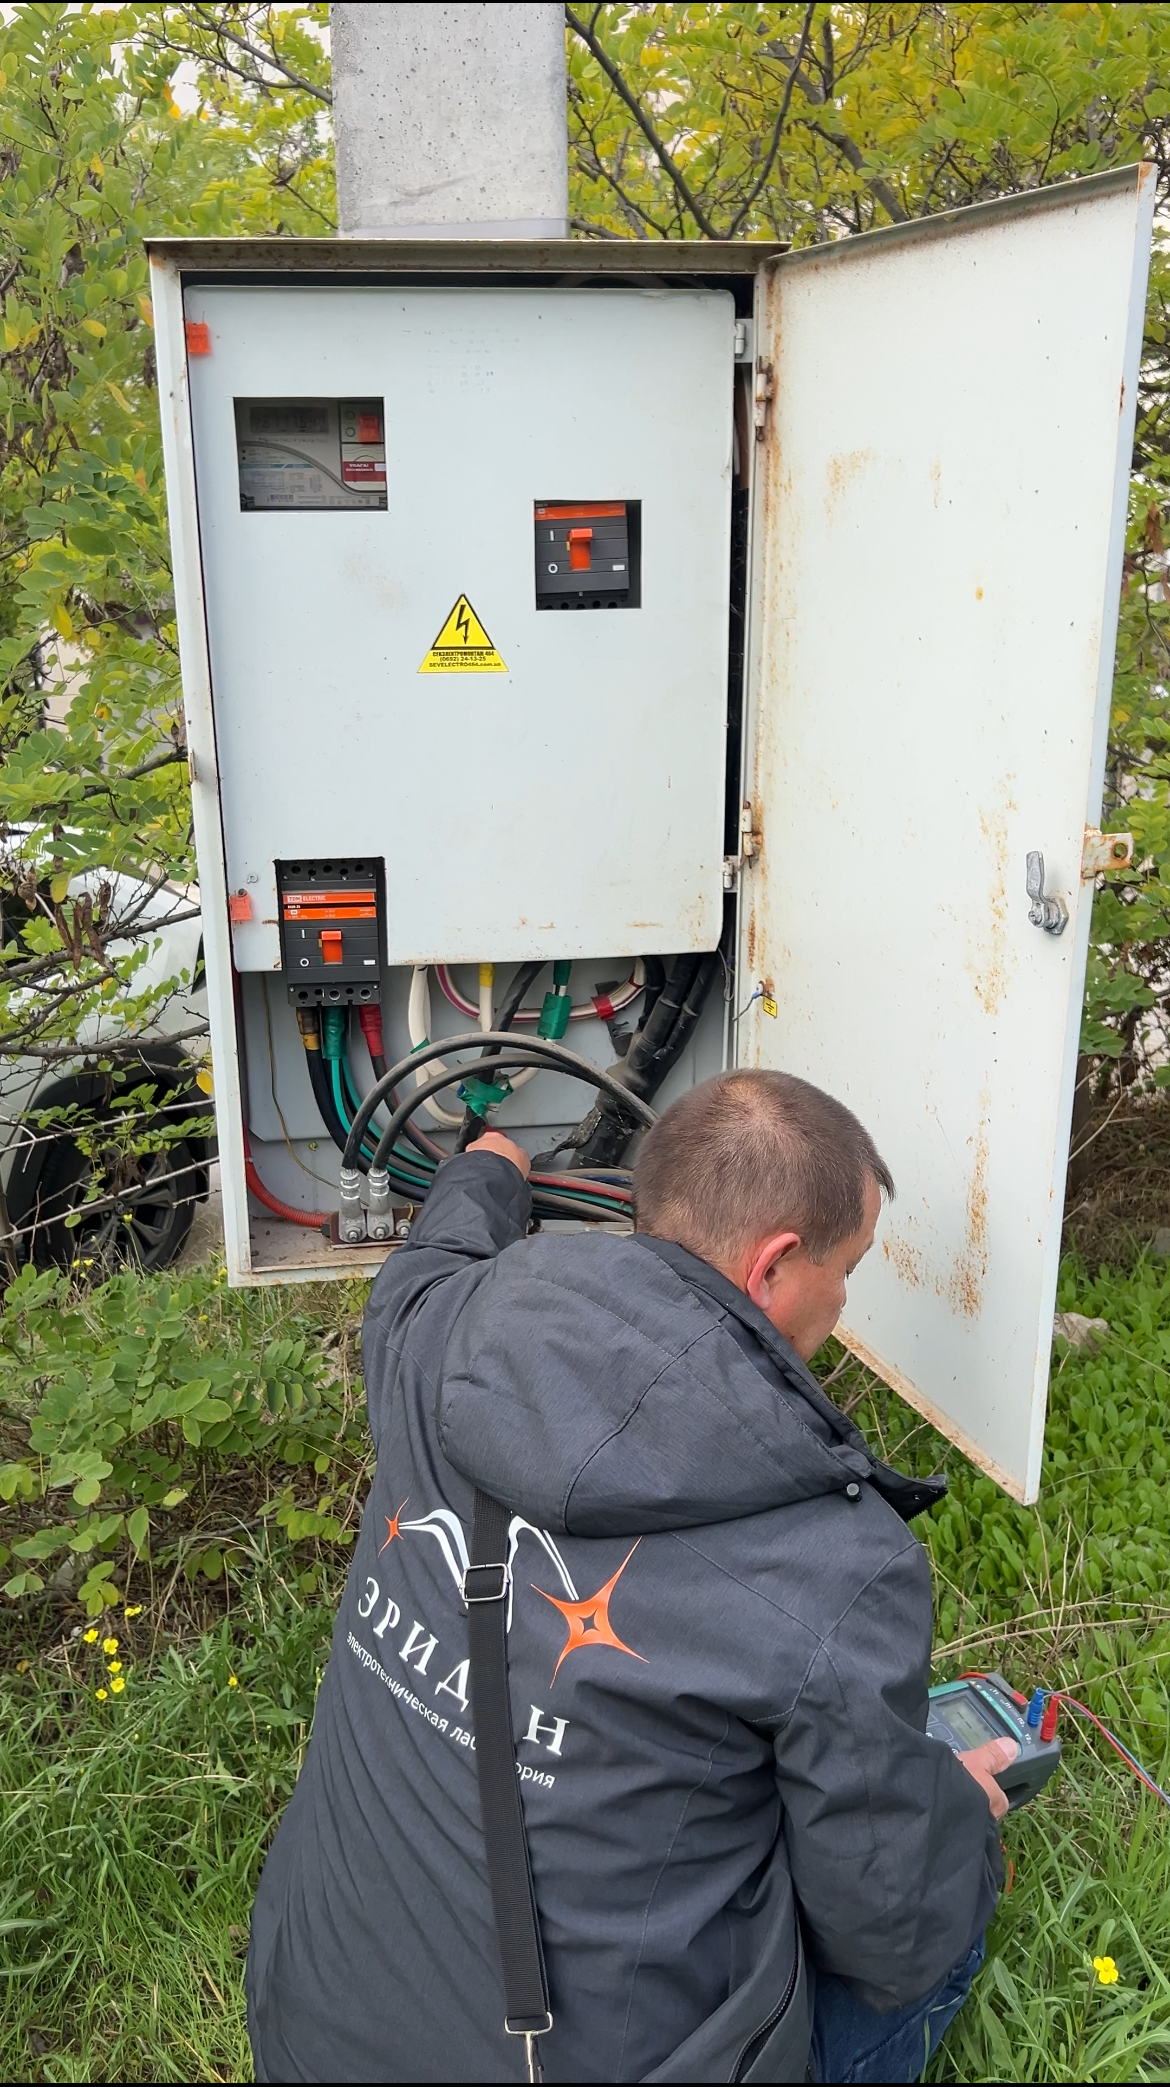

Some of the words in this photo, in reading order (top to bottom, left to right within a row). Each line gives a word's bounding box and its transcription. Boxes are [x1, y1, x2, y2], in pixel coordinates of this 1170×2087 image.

[346, 1631, 449, 1733] электротехническая
[450, 1726, 556, 1789] лаория
[358, 1577, 570, 1756] ЭРИДН
